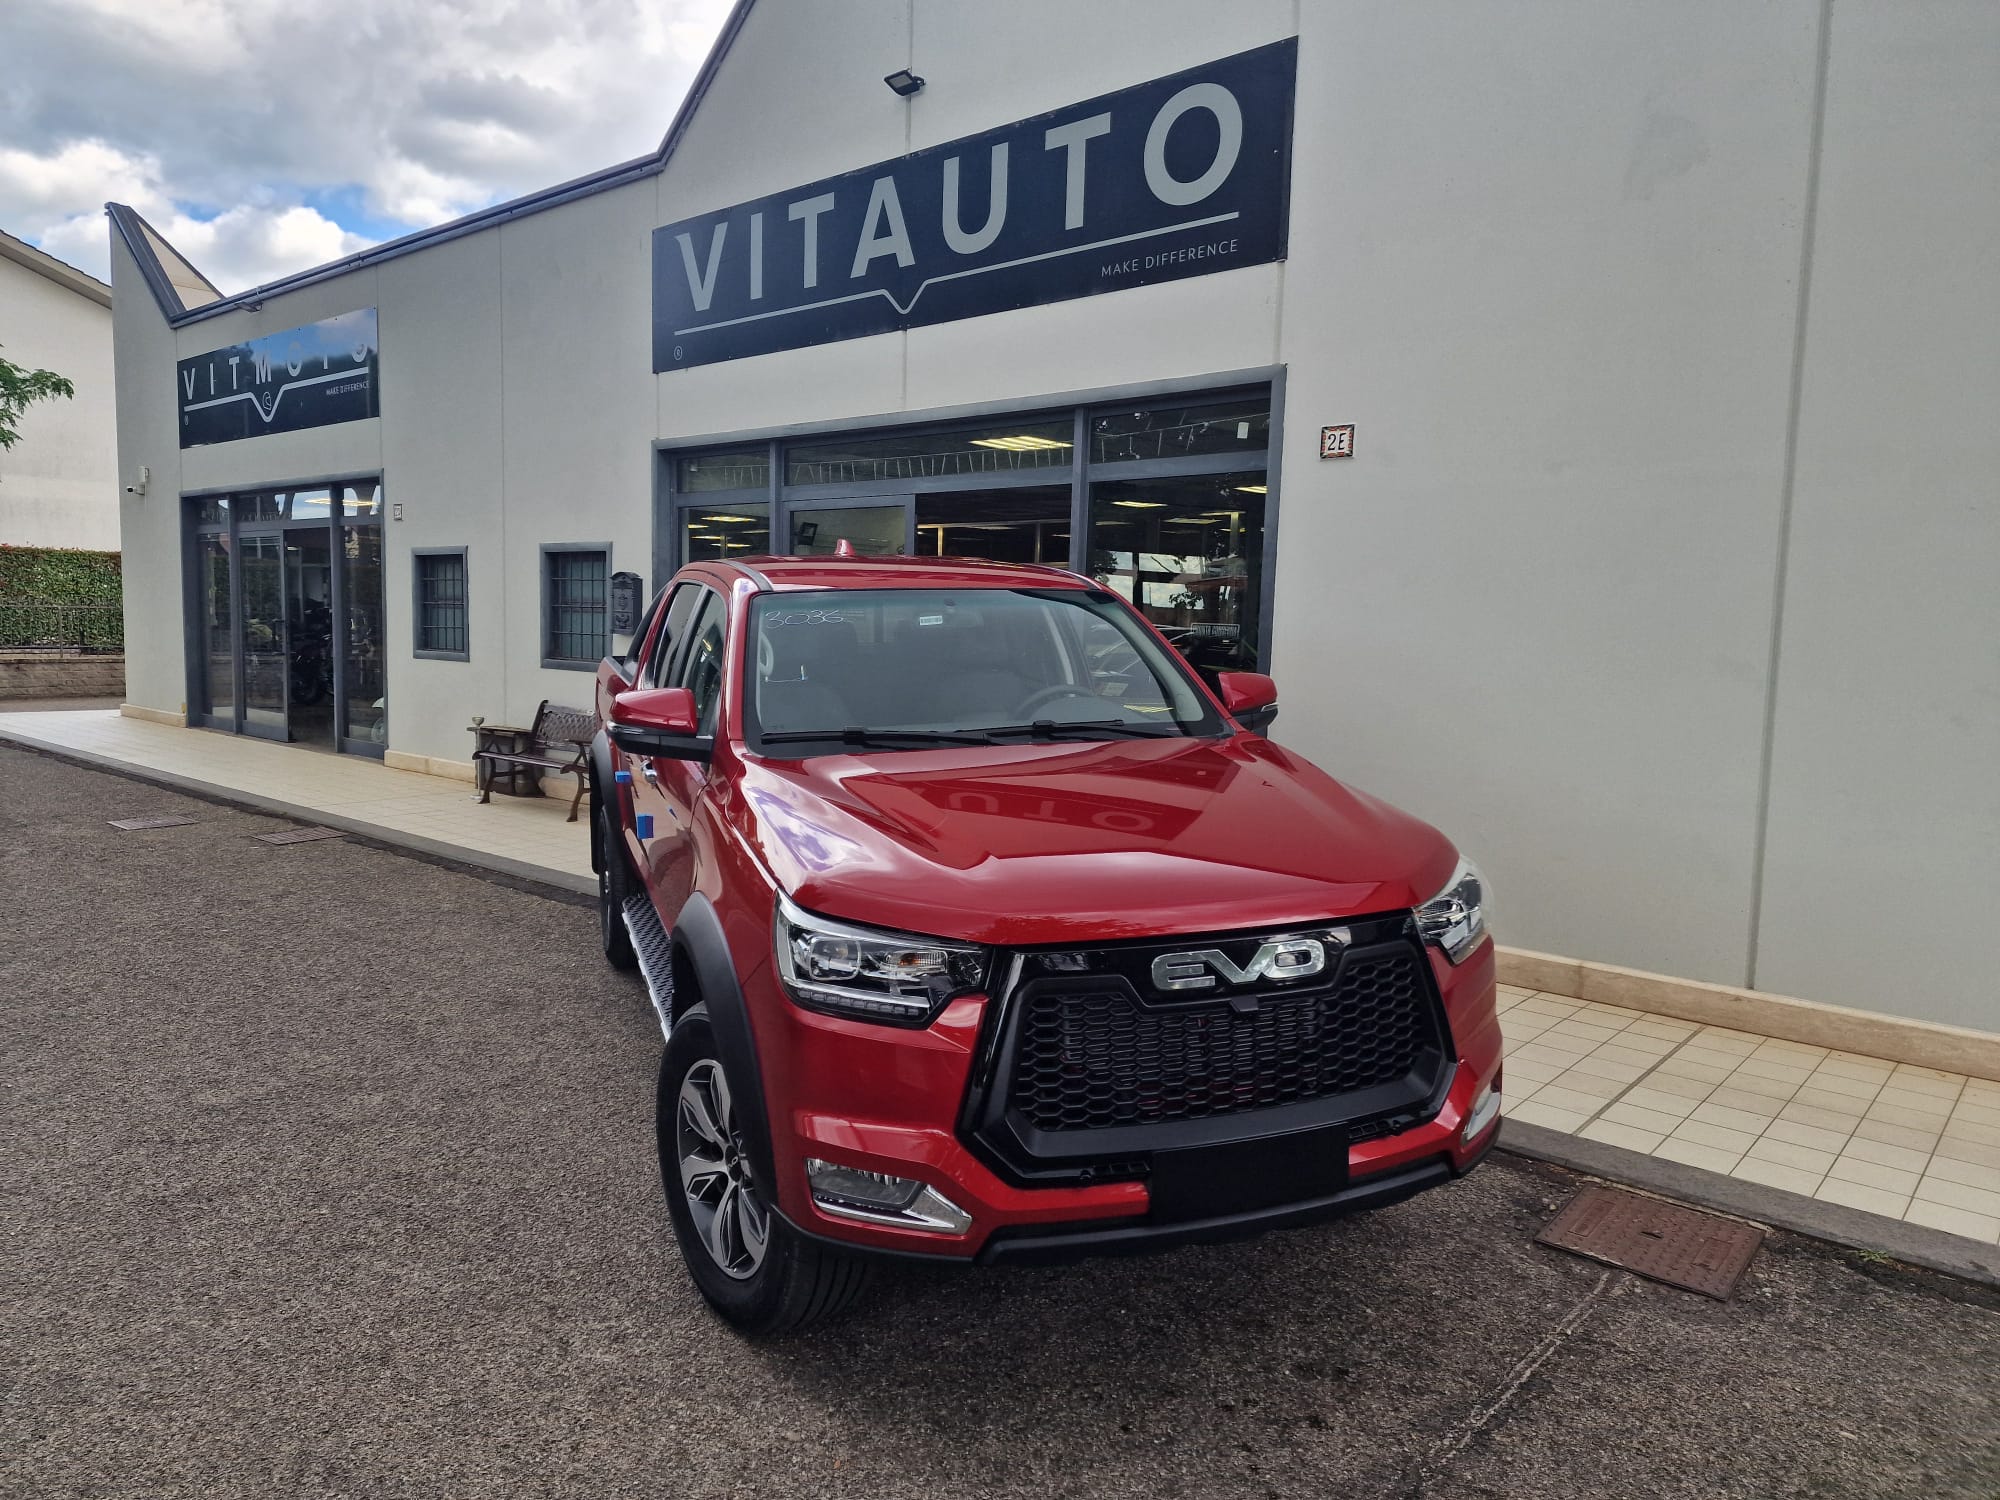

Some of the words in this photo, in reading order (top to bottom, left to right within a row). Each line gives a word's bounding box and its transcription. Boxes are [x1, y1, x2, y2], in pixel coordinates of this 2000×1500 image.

[675, 83, 1242, 312] VITAUTO
[1101, 258, 1139, 277] MAKE
[1145, 239, 1239, 269] DIFFERENCE
[1327, 432, 1347, 450] 2E
[765, 610, 844, 628] 3036
[1152, 939, 1325, 991] EVO
